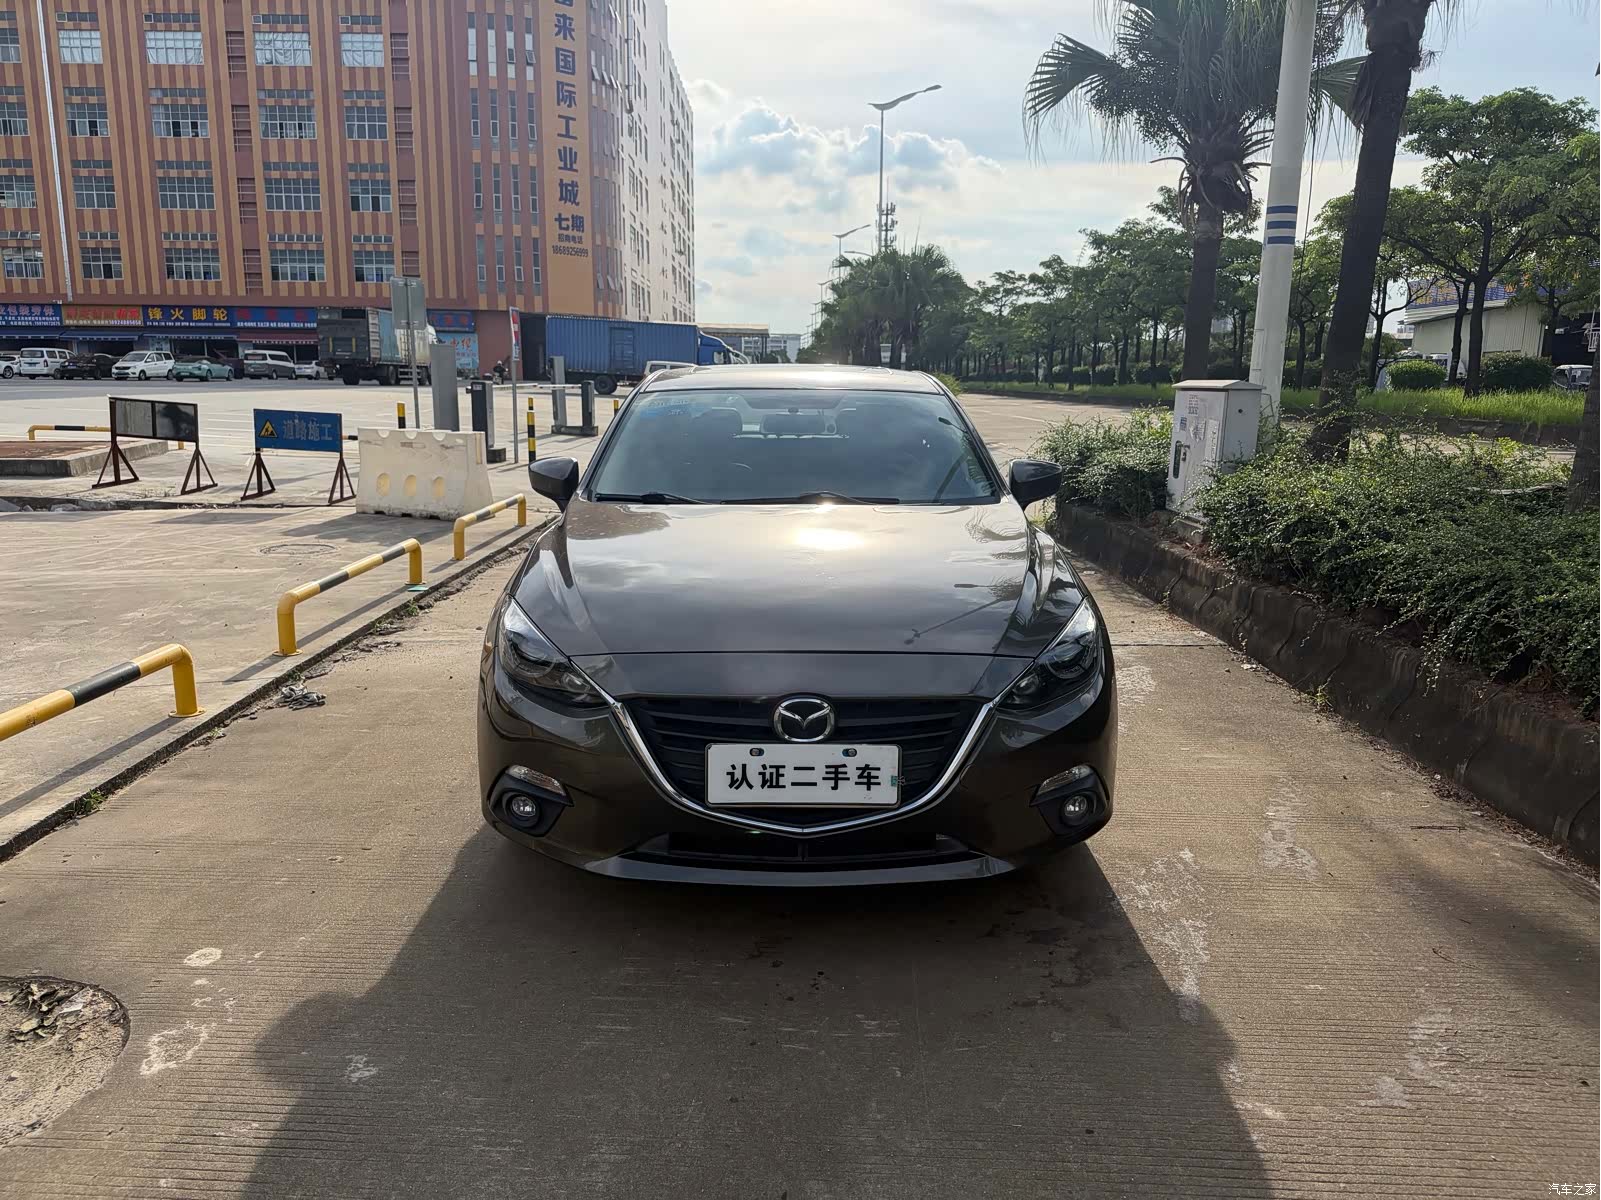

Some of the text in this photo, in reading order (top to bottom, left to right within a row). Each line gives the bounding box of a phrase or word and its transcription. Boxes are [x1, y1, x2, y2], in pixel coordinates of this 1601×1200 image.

[554, 0, 579, 206] 来国际工业城
[554, 212, 584, 233] 七期
[148, 307, 228, 321] 锋火脚轮
[282, 416, 333, 441] 道路施工
[726, 763, 882, 791] 认证二手车
